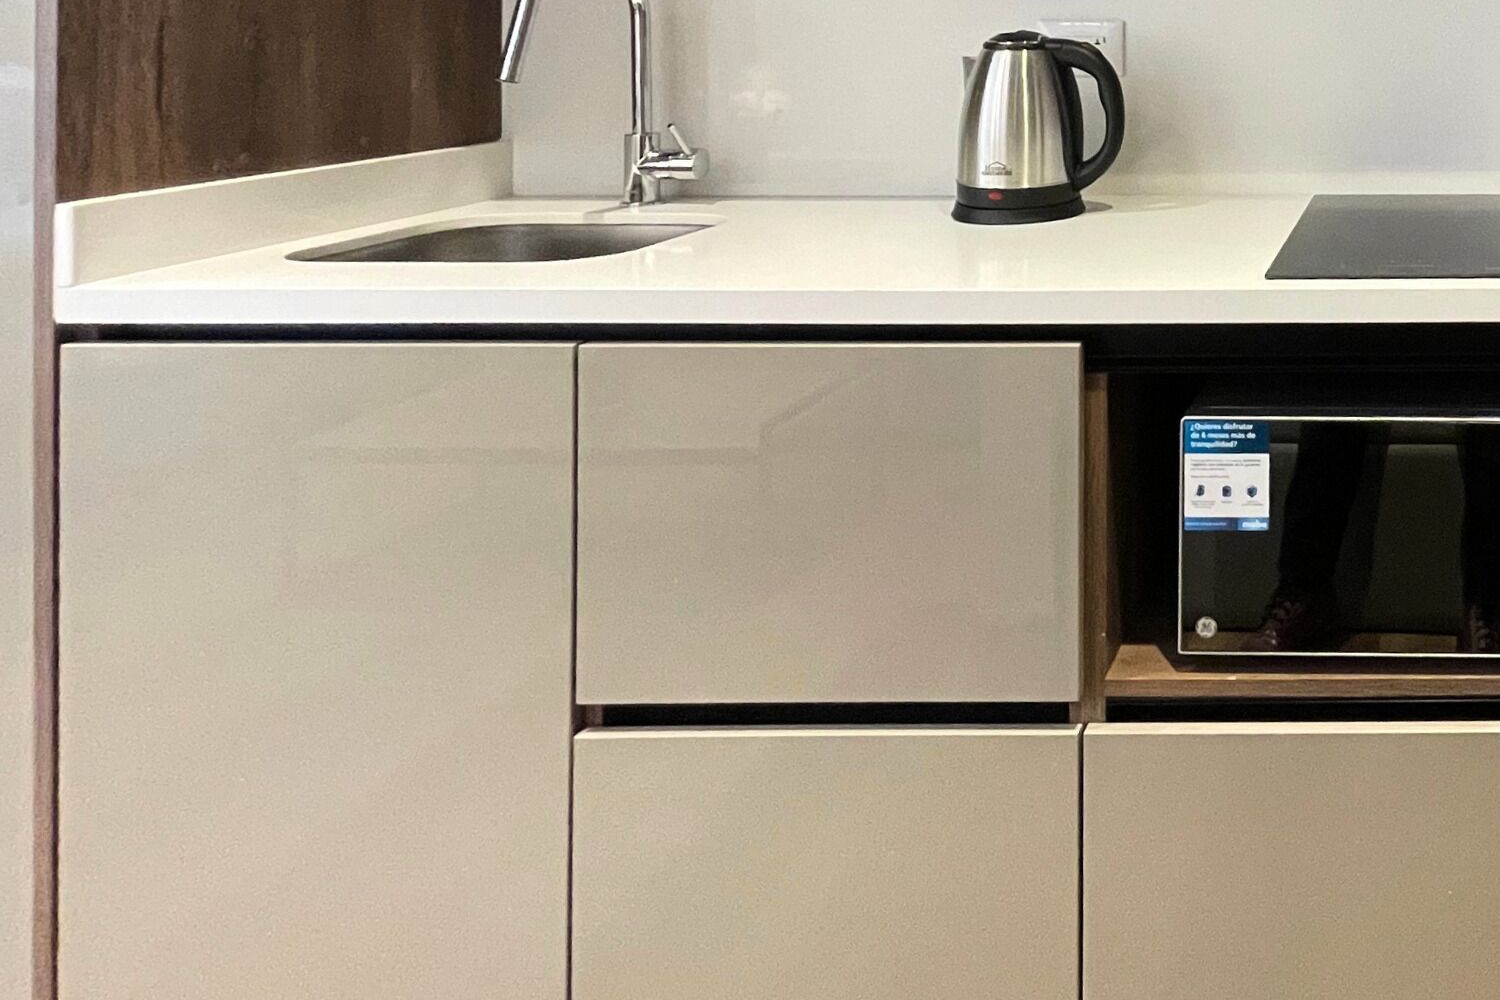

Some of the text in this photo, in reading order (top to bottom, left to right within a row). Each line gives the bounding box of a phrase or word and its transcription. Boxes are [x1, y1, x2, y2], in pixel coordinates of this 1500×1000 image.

[1222, 422, 1253, 430] disfrutar
[1190, 431, 1200, 439] de
[1246, 431, 1256, 439] de
